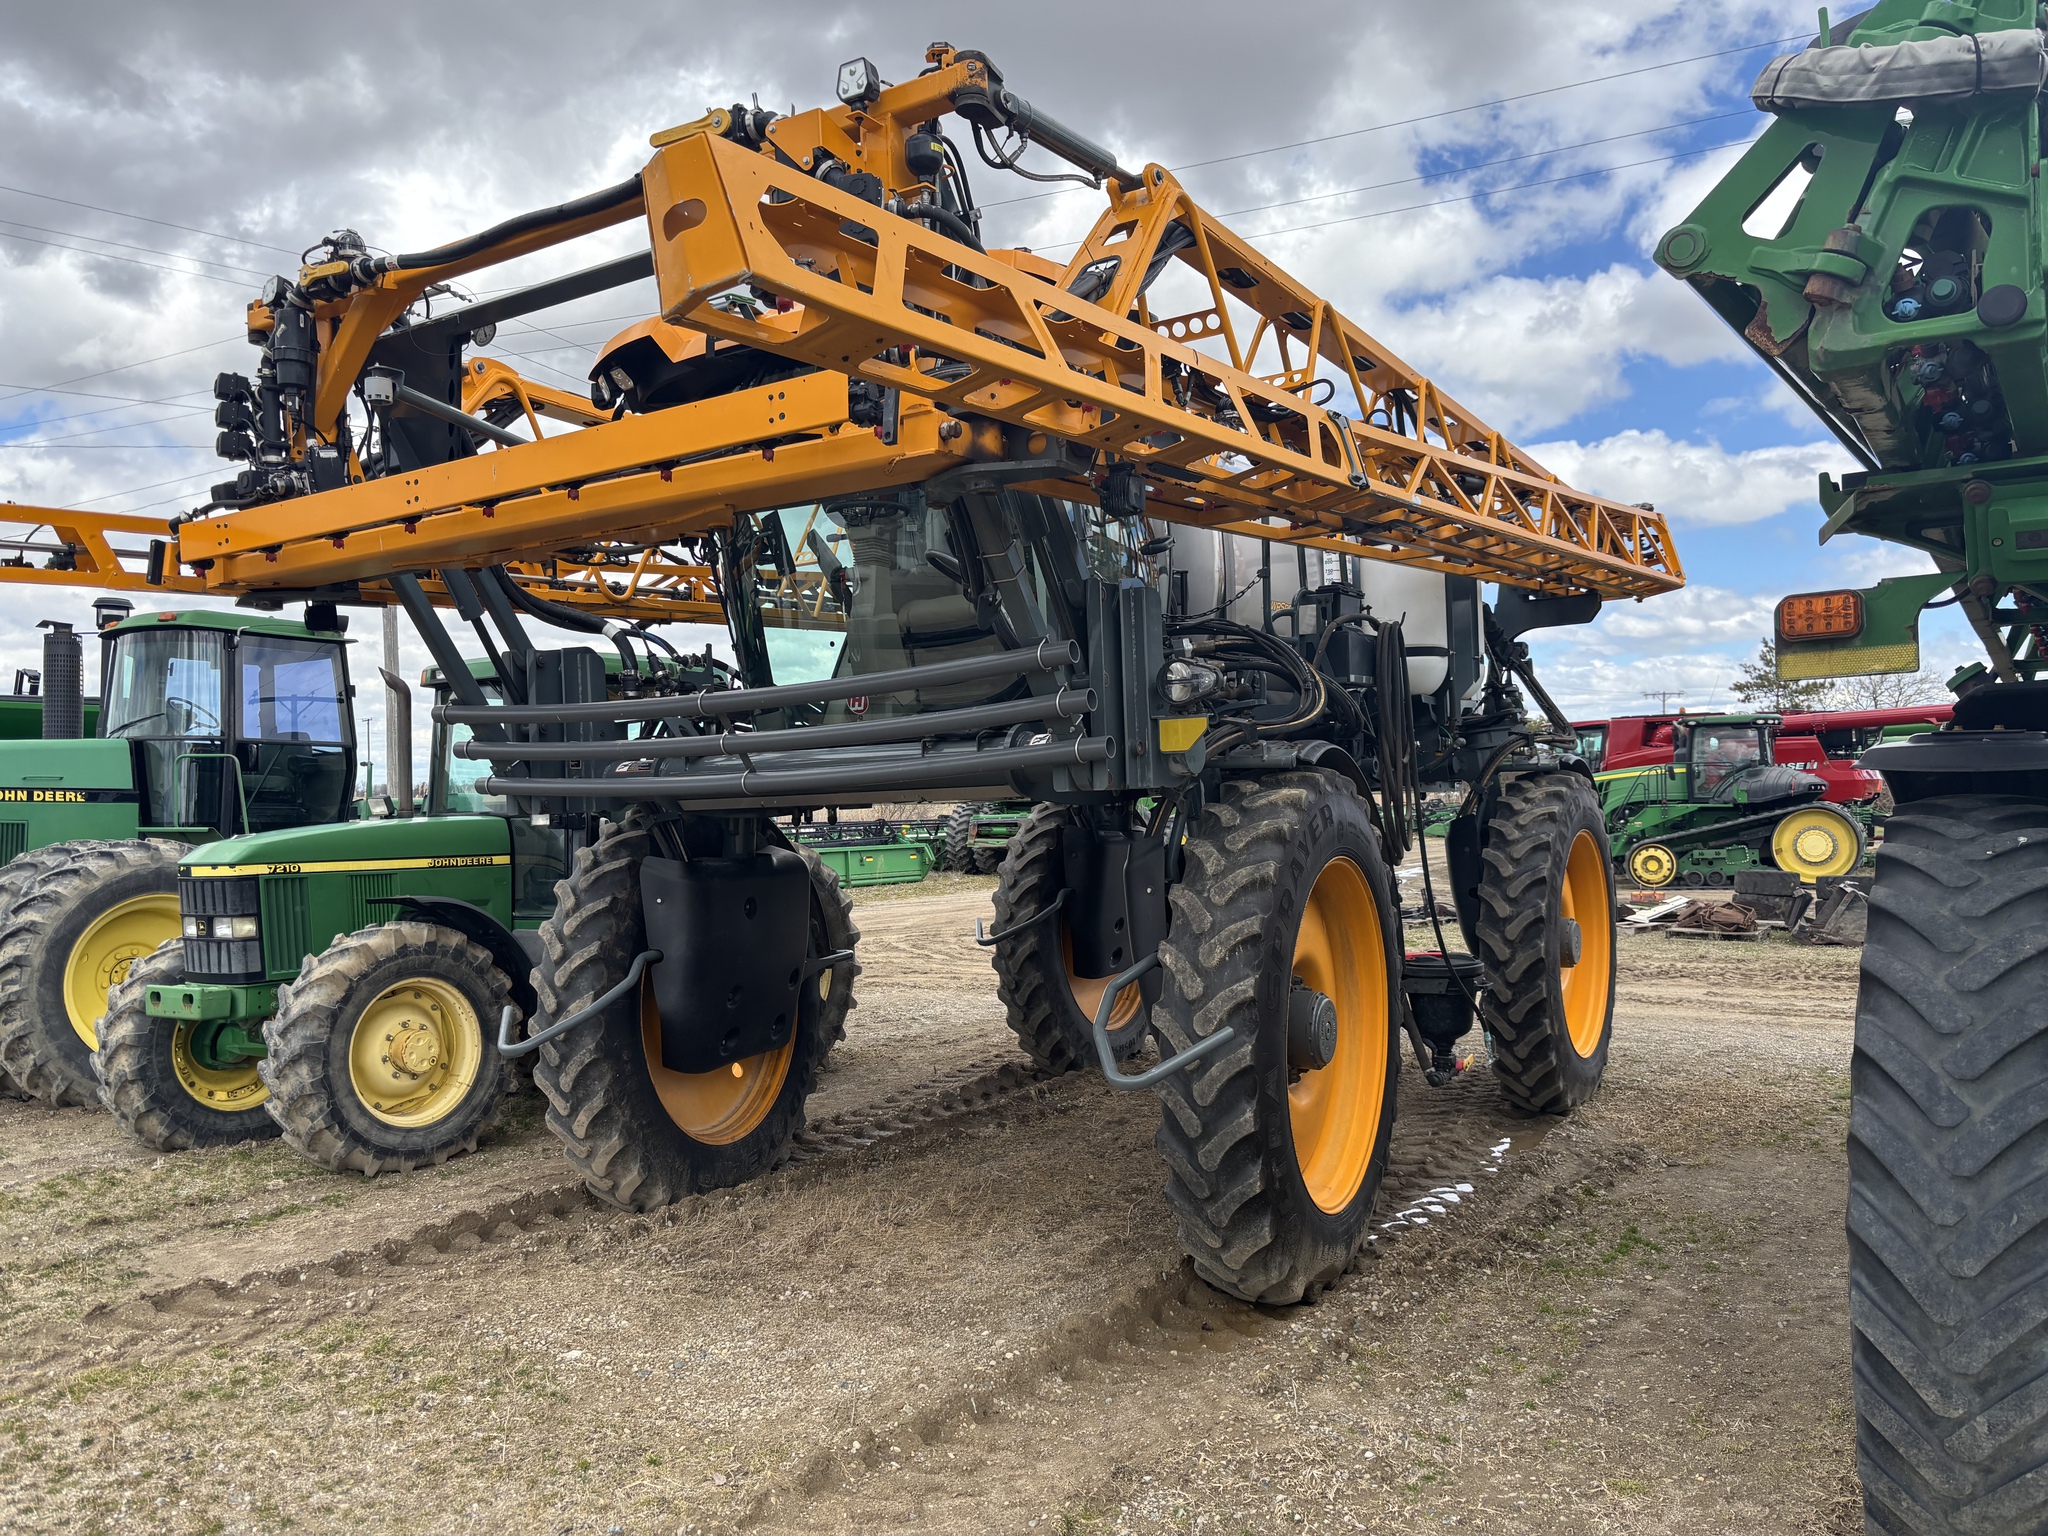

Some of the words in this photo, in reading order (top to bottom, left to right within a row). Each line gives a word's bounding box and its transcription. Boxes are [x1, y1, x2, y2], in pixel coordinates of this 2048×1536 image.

[1775, 762, 1805, 770] ASE
[33, 791, 86, 802] DEERE
[428, 858, 459, 868] JOHN
[461, 856, 492, 867] DEERE
[268, 863, 300, 874] 7210
[1264, 803, 1335, 1013] SPRAYER
